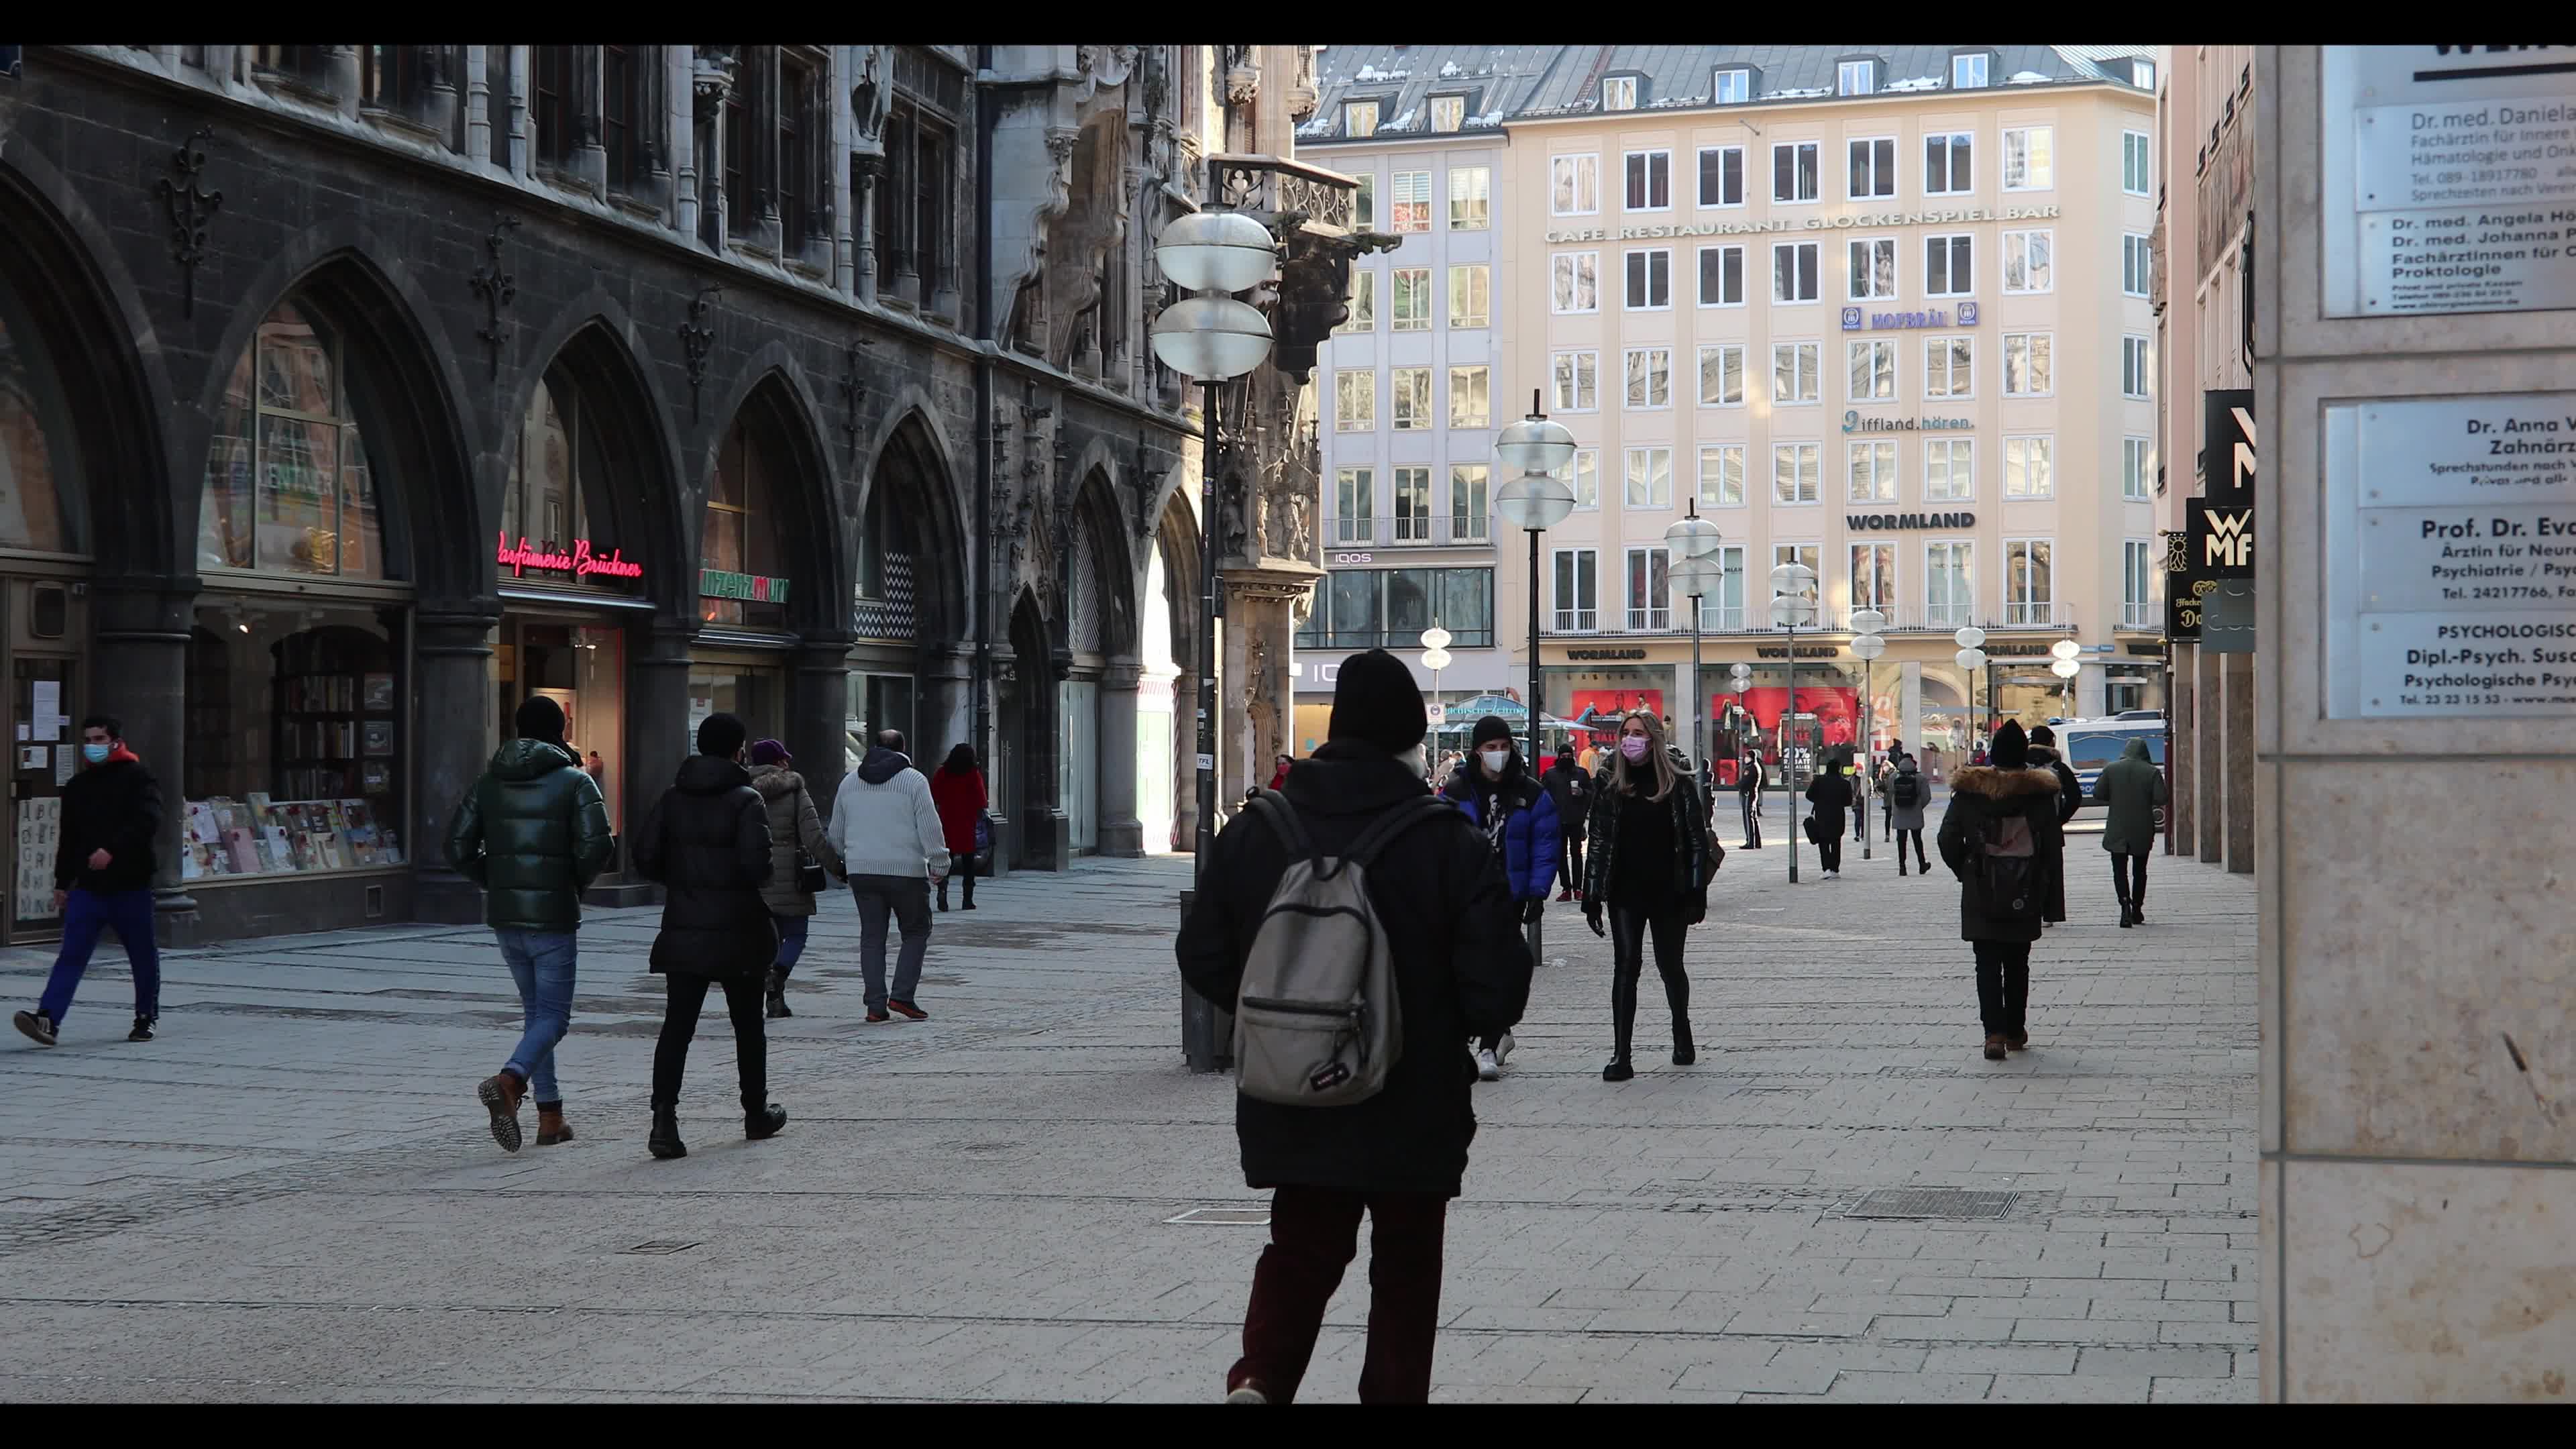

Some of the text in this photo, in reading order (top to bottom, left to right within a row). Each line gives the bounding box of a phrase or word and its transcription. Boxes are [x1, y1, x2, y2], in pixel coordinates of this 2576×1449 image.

[2412, 113, 2439, 130] Dr.
[2443, 108, 2496, 127] med.
[2493, 129, 2515, 143] für
[2412, 148, 2508, 166] Hämatologie
[2512, 145, 2542, 160] und
[1619, 219, 1789, 239] RESTAURANT
[1803, 208, 1996, 230] GLOCKENSPIEL
[2006, 204, 2061, 219] BAR
[2392, 218, 2419, 230] Dr.
[2425, 215, 2471, 228] med.
[2478, 211, 2544, 227] Angela
[2392, 235, 2419, 248] Dr.
[2425, 233, 2471, 246] med.
[2477, 229, 2559, 244] Johanna
[2392, 248, 2526, 264] Fachärztinnen
[2533, 246, 2559, 258] für
[2392, 264, 2502, 279] Proktologie
[2467, 419, 2497, 434] Dr.
[2504, 418, 2559, 433] Anna
[2429, 460, 2528, 476] Sprechstunden
[2533, 458, 2565, 470] nach
[1846, 512, 1975, 530] WORMLAND
[2421, 518, 2481, 538] Prof.
[2492, 519, 2527, 537] Dr.
[572, 539, 642, 577] Brückner
[2442, 541, 2493, 558] Ärztin
[2499, 543, 2524, 557] für
[1335, 553, 1373, 565] IQOS
[2432, 564, 2524, 580] Psychiatrie
[2443, 588, 2467, 599] Tel.
[1567, 649, 1647, 660] WORMLAND
[2407, 647, 2525, 667] Dipl.-Psych.
[2404, 673, 2536, 690] Psychologische
[2400, 695, 2420, 704] Tel.
[1783, 731, 1810, 741] SLE
[2080, 785, 2094, 793] PO
